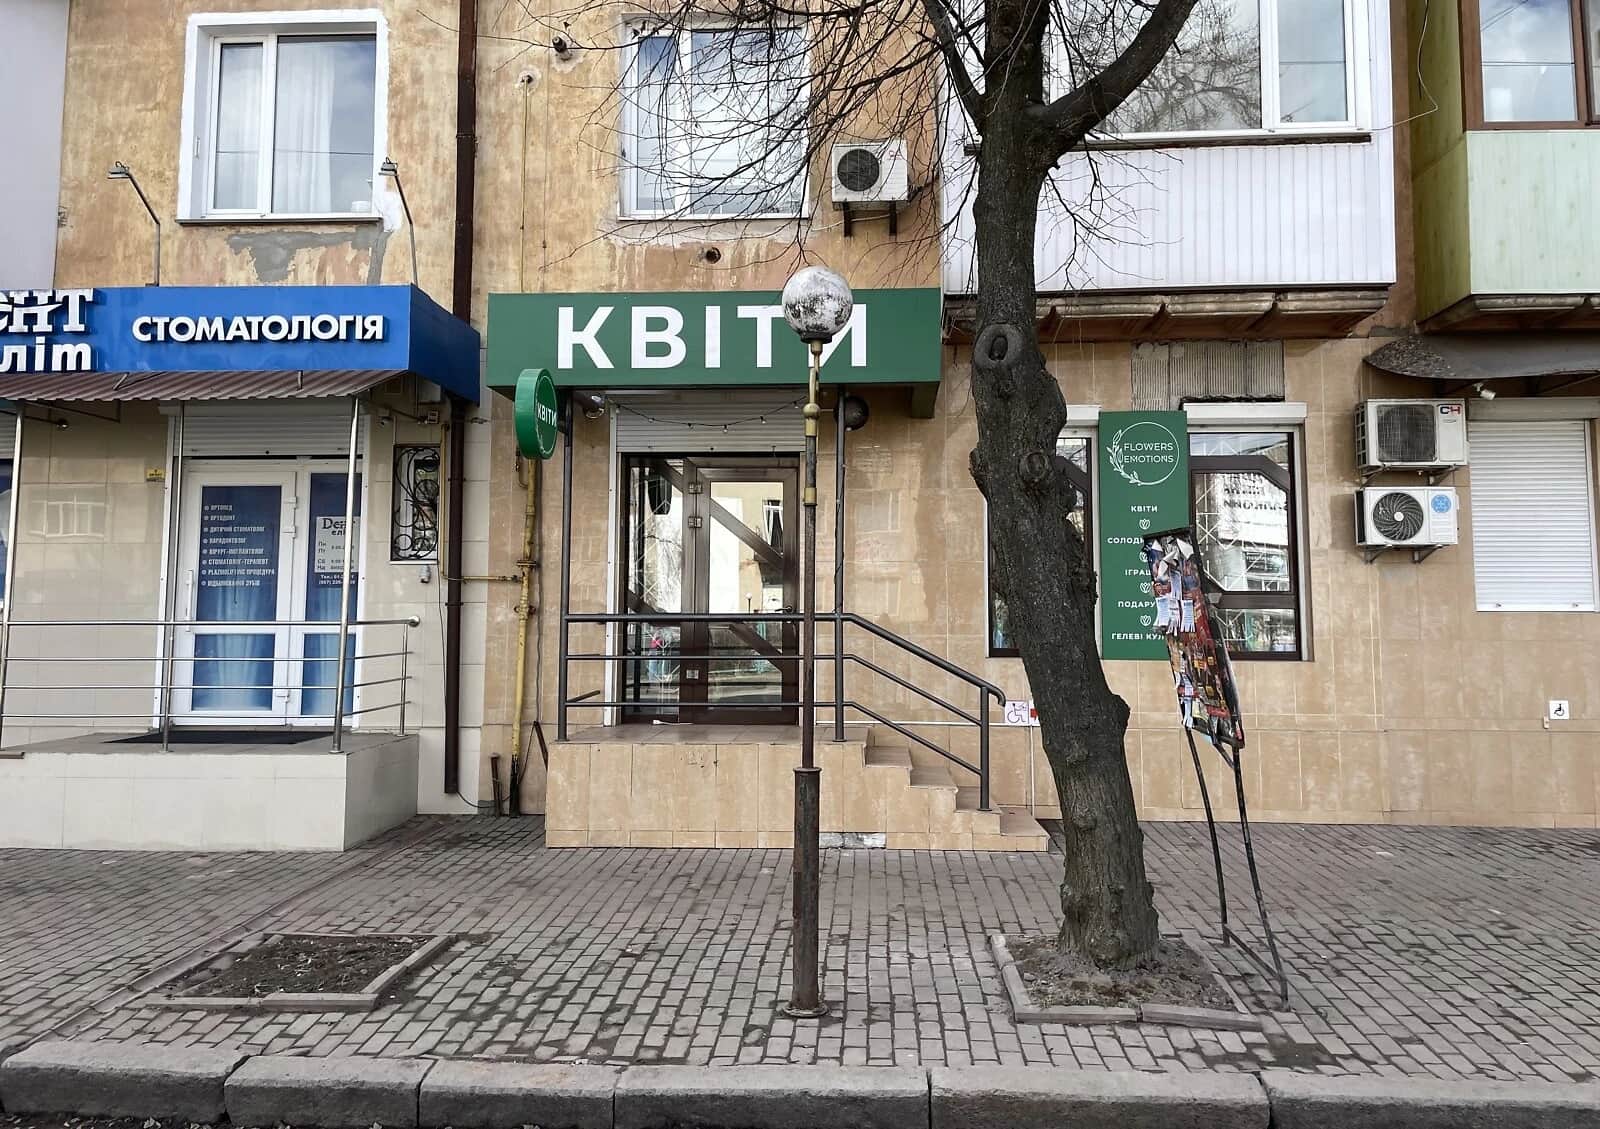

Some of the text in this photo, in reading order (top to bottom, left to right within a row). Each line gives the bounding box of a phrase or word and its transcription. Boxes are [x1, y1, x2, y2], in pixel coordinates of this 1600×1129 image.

[132, 314, 384, 342] СТОМАТОЛОГІЯ
[537, 402, 557, 427] КВІТИ
[1124, 442, 1174, 451] FLOWERS
[1124, 455, 1174, 463] EMOTIONS
[1131, 505, 1158, 513] КВІТИ
[1107, 537, 1144, 545] СОЛОДК
[1125, 569, 1151, 577] ІГРАШ
[1118, 601, 1156, 609] ПОДАРУ
[1111, 632, 1165, 641] ГЕЛЕВІ КУЛ
